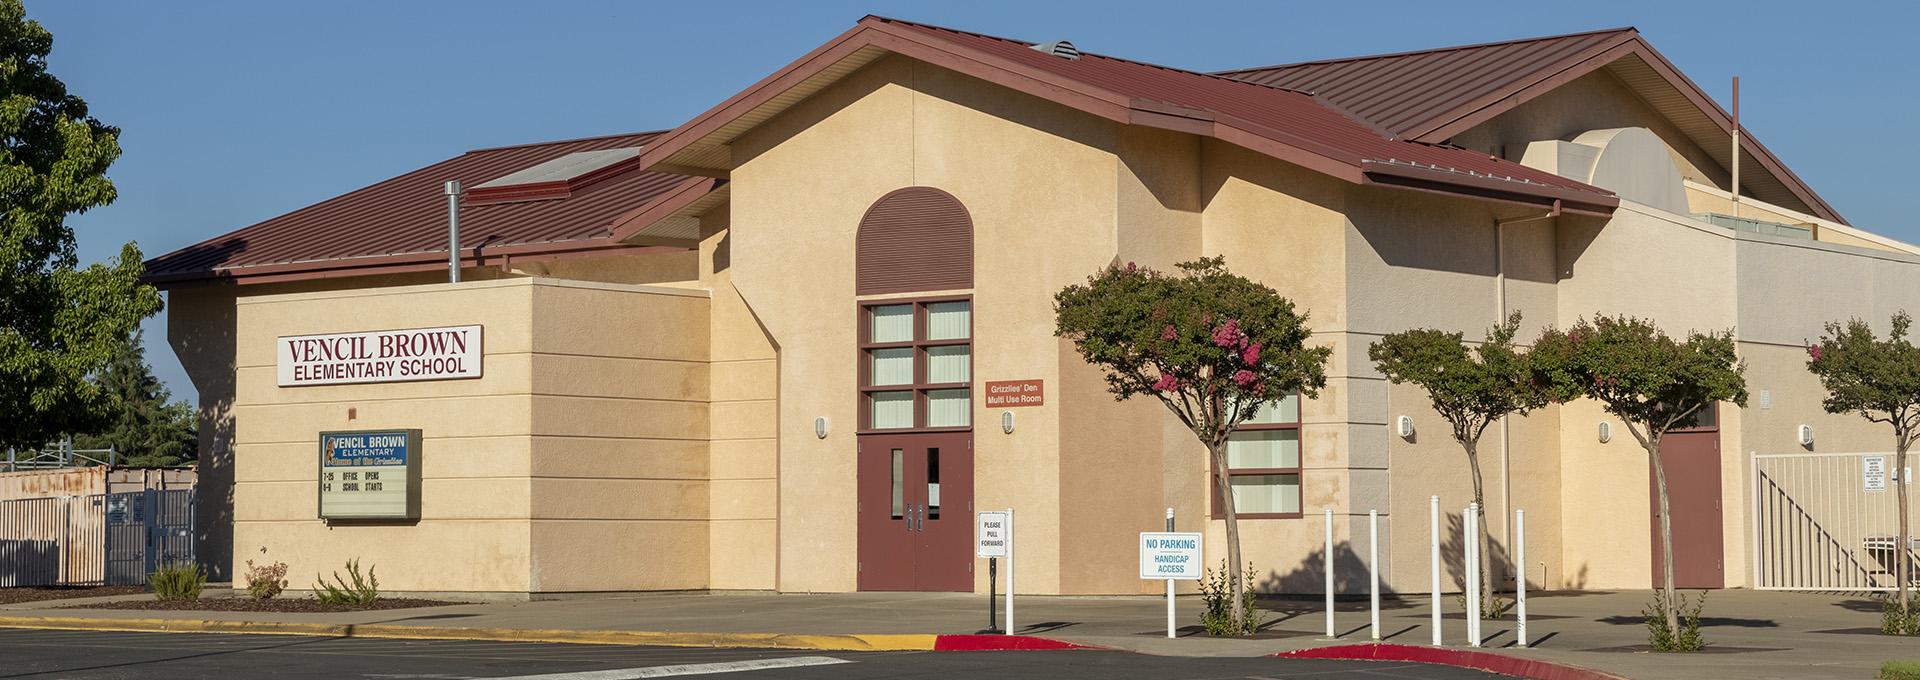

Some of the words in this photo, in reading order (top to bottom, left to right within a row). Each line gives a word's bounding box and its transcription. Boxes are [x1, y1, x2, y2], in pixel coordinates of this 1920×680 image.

[288, 336, 373, 362] VENCIL
[378, 330, 468, 358] BROWN
[294, 361, 395, 381] ELEMENTARY
[400, 357, 467, 376] SCHOOL
[1024, 384, 1038, 392] Den
[988, 396, 1005, 404] Multi
[1006, 395, 1020, 403] Use
[1021, 394, 1041, 402] Room
[333, 437, 366, 448] VENCIL
[369, 435, 405, 448] BROWN
[342, 448, 395, 457] ELEMENTARY
[342, 471, 358, 480] OFFICE
[365, 471, 380, 480] OPENS
[342, 482, 359, 492] SCHOOL
[365, 482, 382, 491] STARTS
[1146, 539, 1158, 549] NO
[1160, 539, 1196, 549] PARKING
[1154, 555, 1190, 563] HANDICAP
[1158, 565, 1185, 573] ACCESS
